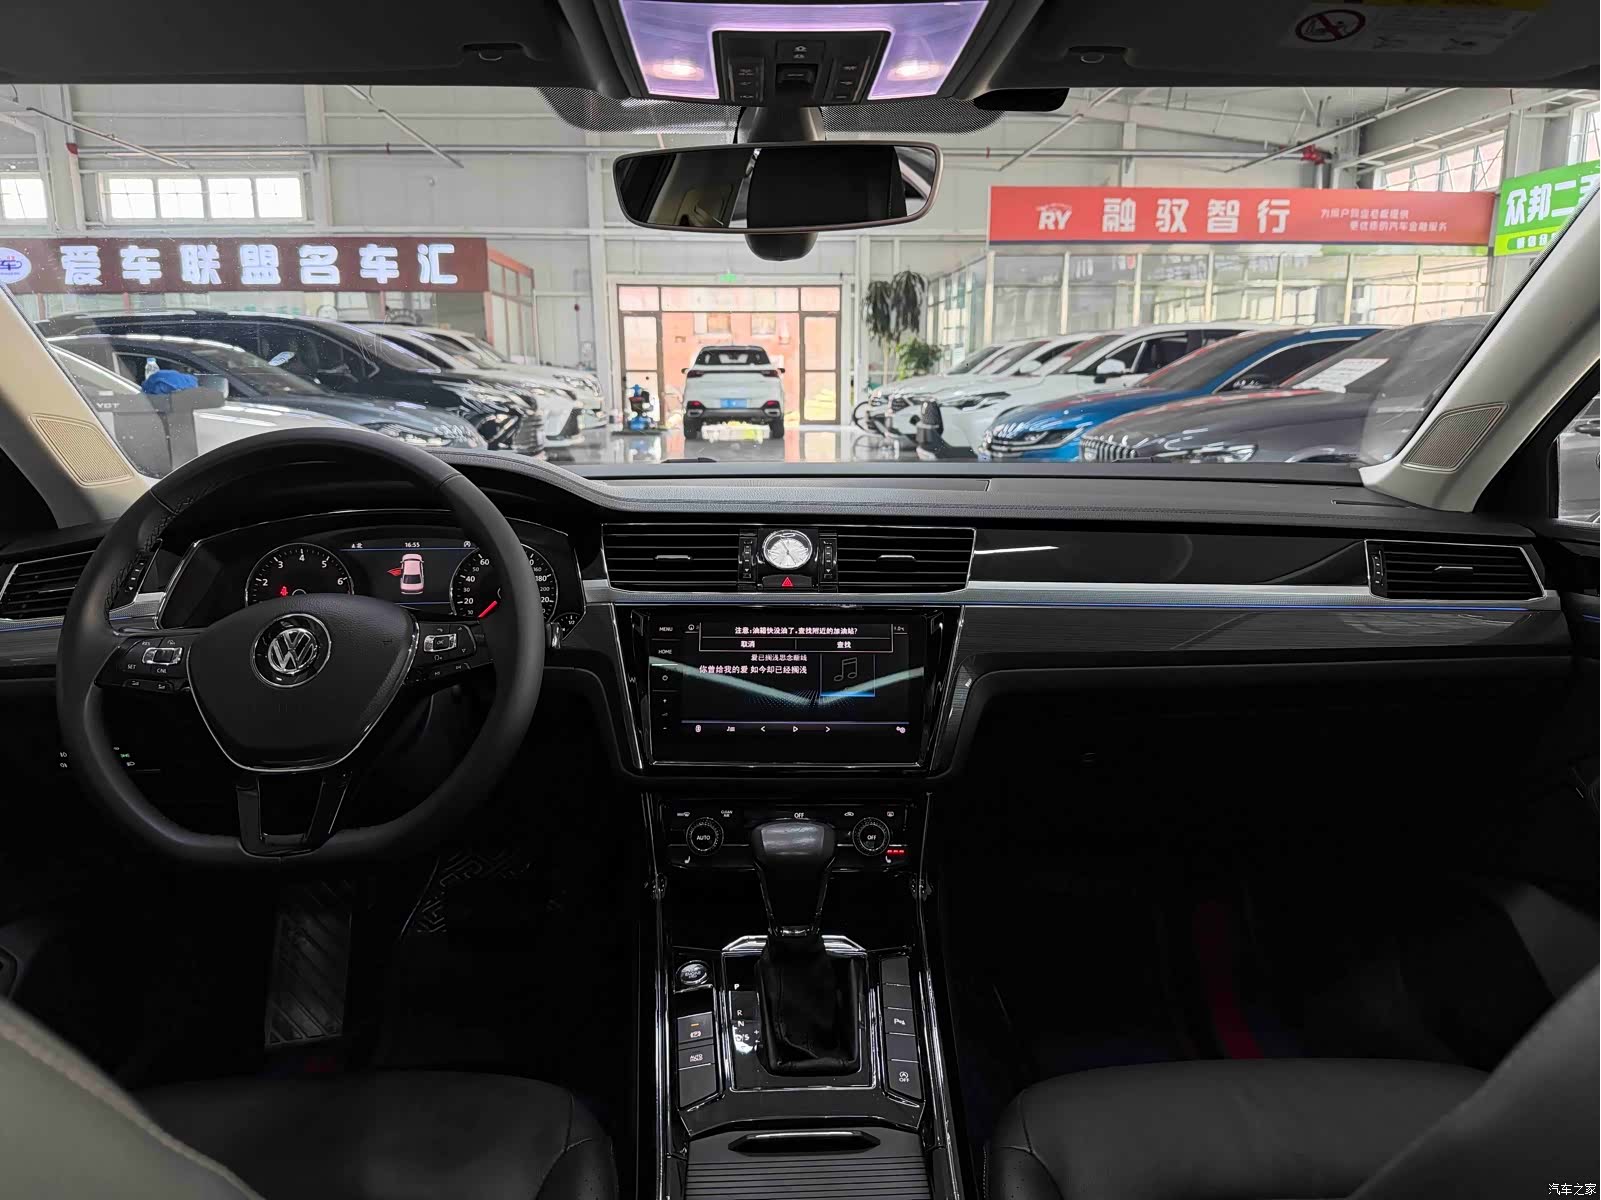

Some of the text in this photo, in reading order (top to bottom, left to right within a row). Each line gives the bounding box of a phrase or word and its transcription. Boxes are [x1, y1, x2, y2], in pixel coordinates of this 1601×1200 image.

[1101, 198, 1291, 234] 融驭智行
[60, 244, 459, 286] 爱车联盟名车汇
[277, 561, 284, 569] 3
[321, 560, 328, 568] 5
[337, 577, 344, 585] 6
[740, 640, 755, 648] 取消
[836, 641, 851, 649] 查找
[699, 665, 808, 675] 你曾给我的爱 如今却已经搁浅
